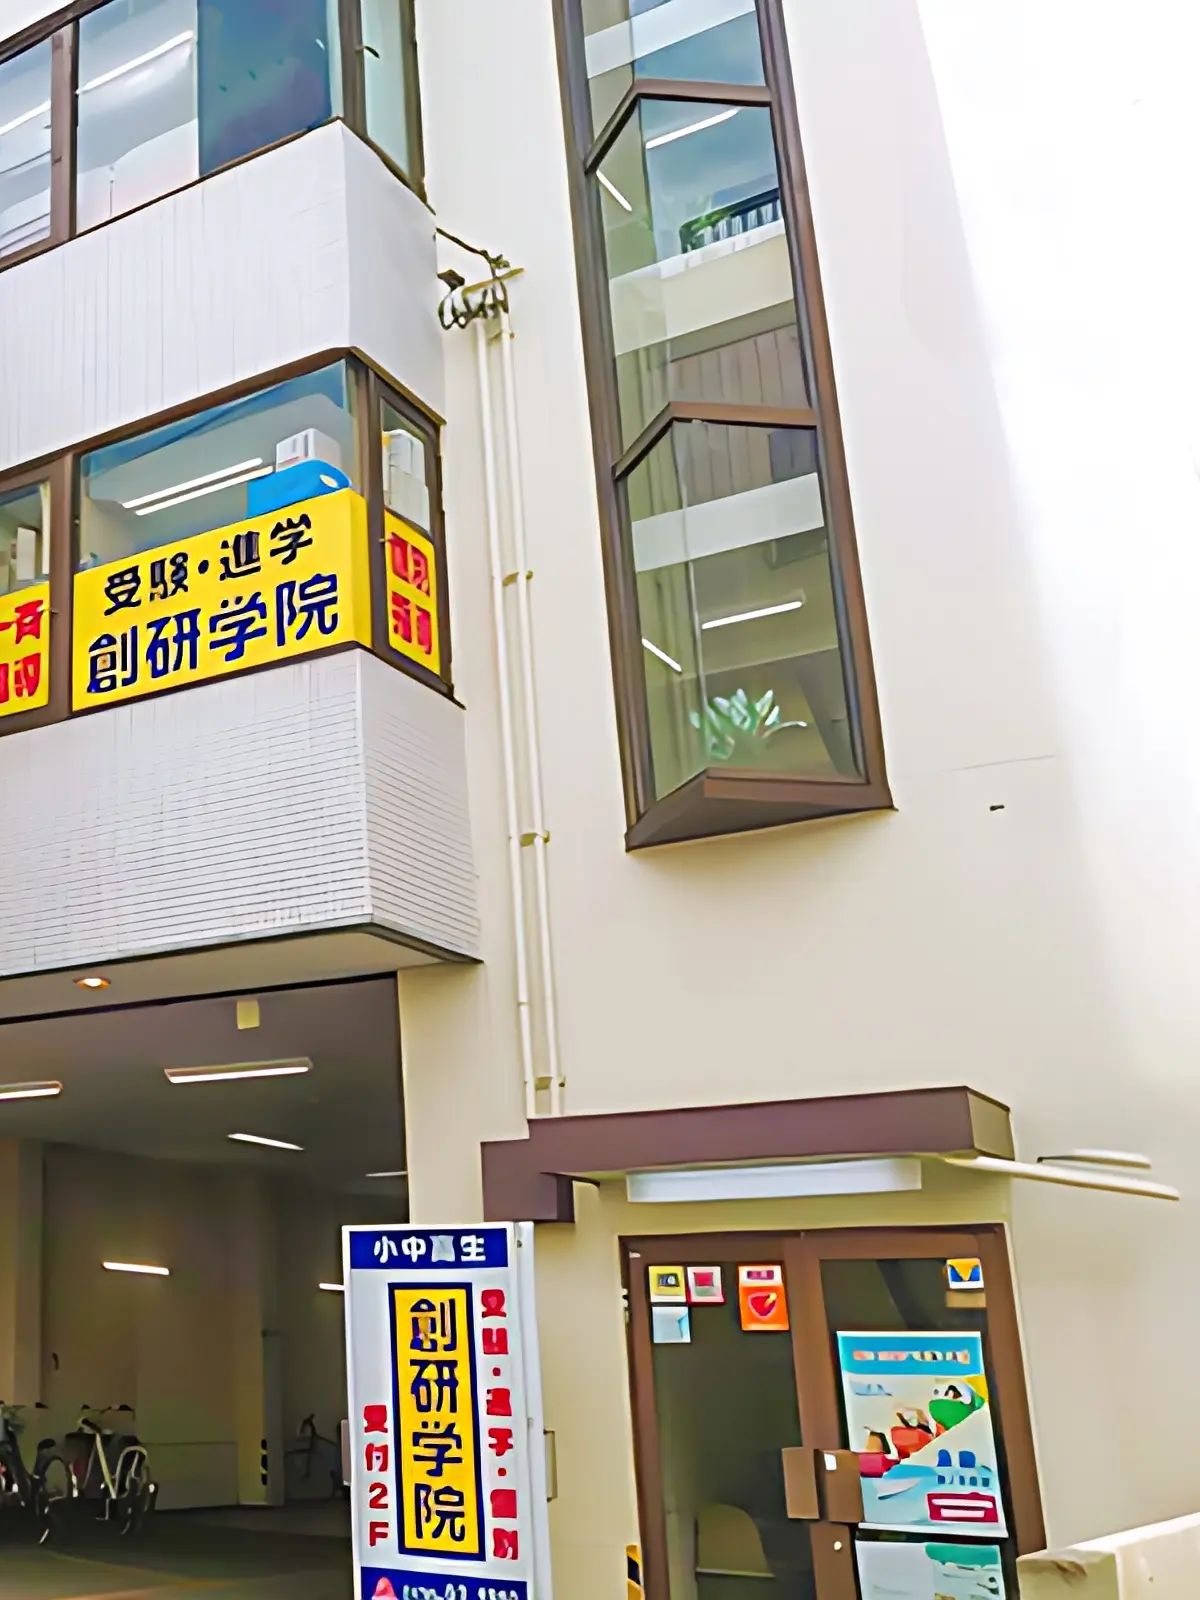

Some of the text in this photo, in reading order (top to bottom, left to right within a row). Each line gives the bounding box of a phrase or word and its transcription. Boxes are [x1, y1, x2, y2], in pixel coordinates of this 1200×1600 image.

[104, 513, 313, 616] 受験・進学
[87, 572, 338, 694] 創研学院
[410, 1298, 466, 1542] 創研学院
